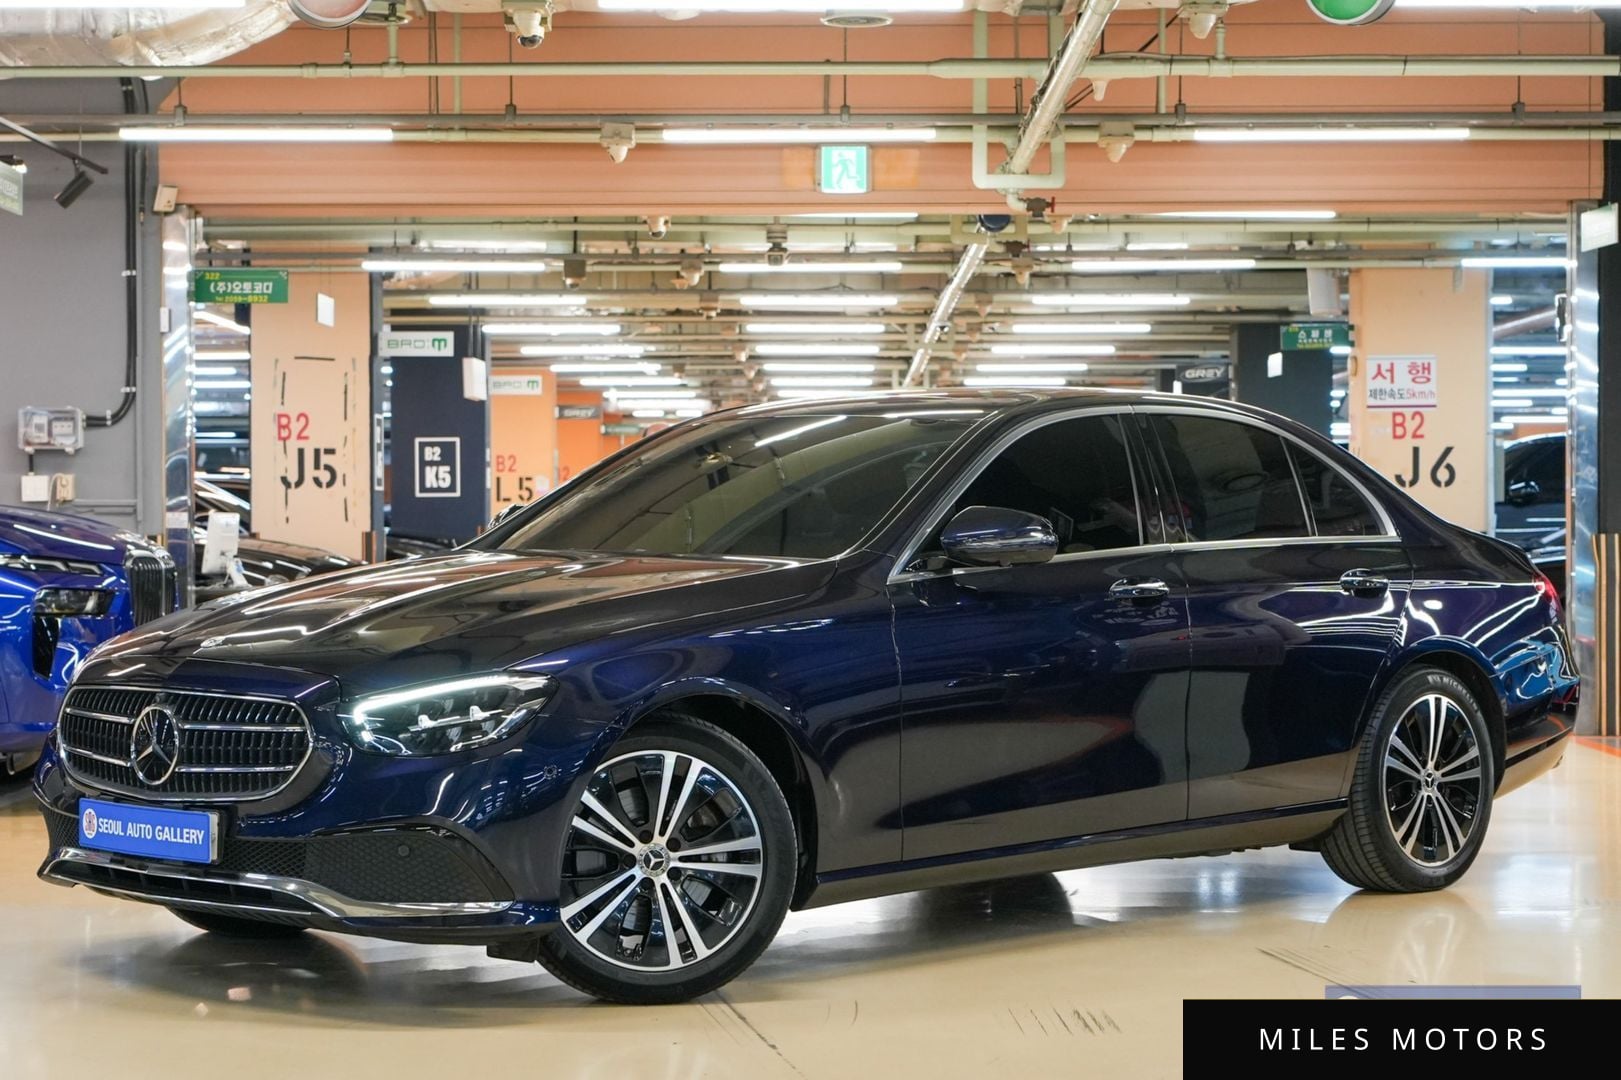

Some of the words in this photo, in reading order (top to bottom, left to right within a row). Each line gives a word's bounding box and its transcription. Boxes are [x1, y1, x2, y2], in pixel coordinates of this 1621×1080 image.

[1185, 366, 1225, 379] GREY
[277, 412, 310, 441] B2
[1392, 410, 1425, 440] B2
[424, 446, 442, 461] B2
[496, 454, 517, 472] B2
[1394, 446, 1456, 488] J6
[280, 447, 338, 489] J5
[425, 466, 451, 488] K5
[98, 818, 125, 836] SEOUL
[126, 822, 152, 840] AUTO
[155, 826, 205, 845] GALLERY
